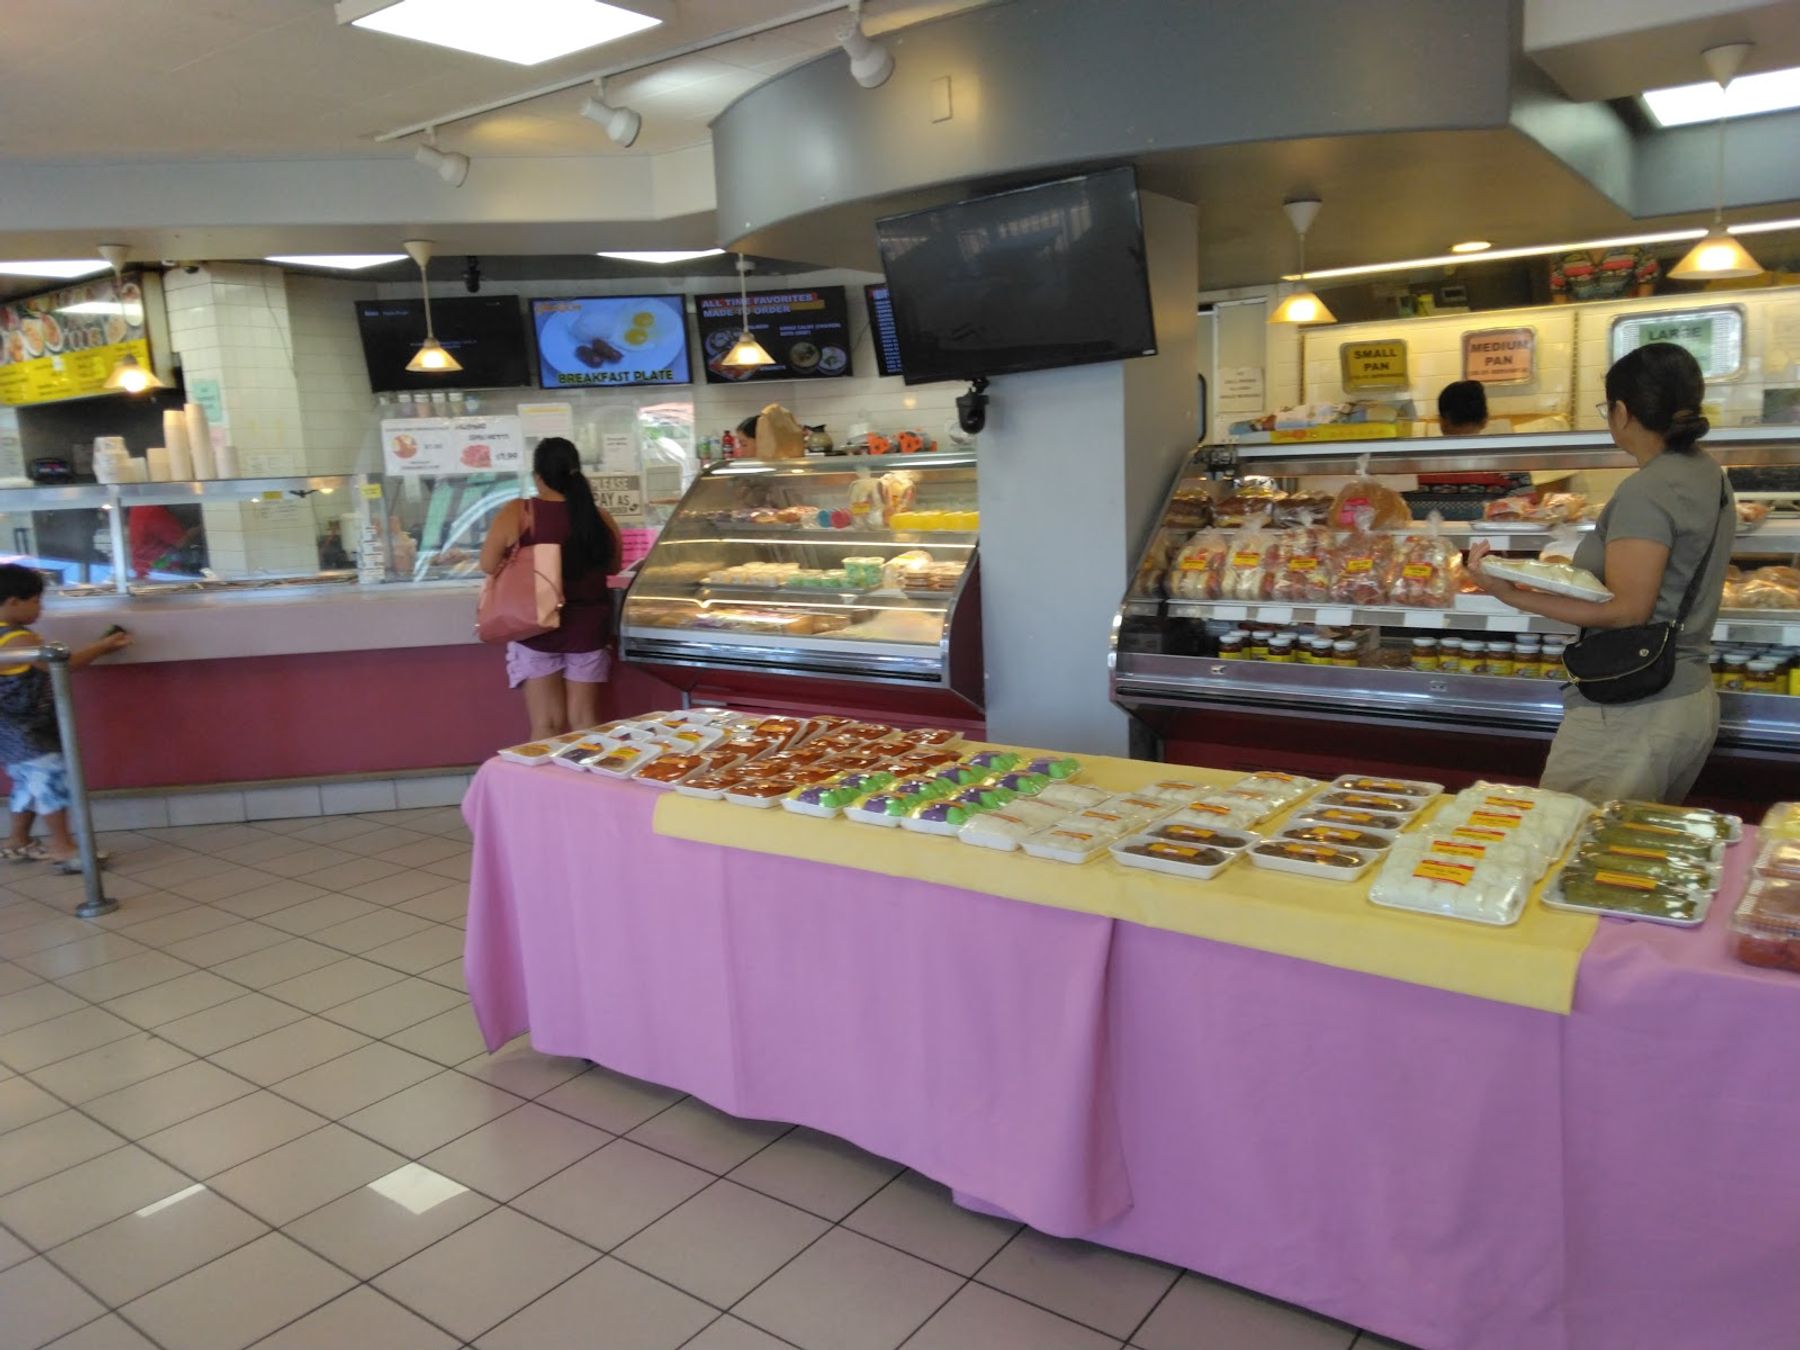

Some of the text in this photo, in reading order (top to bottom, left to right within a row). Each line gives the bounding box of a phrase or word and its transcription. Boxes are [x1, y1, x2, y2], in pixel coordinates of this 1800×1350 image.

[702, 293, 813, 309] ALL TIME FAVORITES
[703, 308, 734, 318] MADE
[753, 305, 791, 316] ORDER
[1649, 327, 1702, 340] LARGE
[1471, 340, 1529, 353] MEDIUM
[1354, 348, 1397, 359] SMALL
[1363, 362, 1390, 372] PAN
[1485, 355, 1513, 366] PAN
[558, 369, 673, 384] BREAKFAST PLATE
[592, 491, 630, 507] PAY AS
